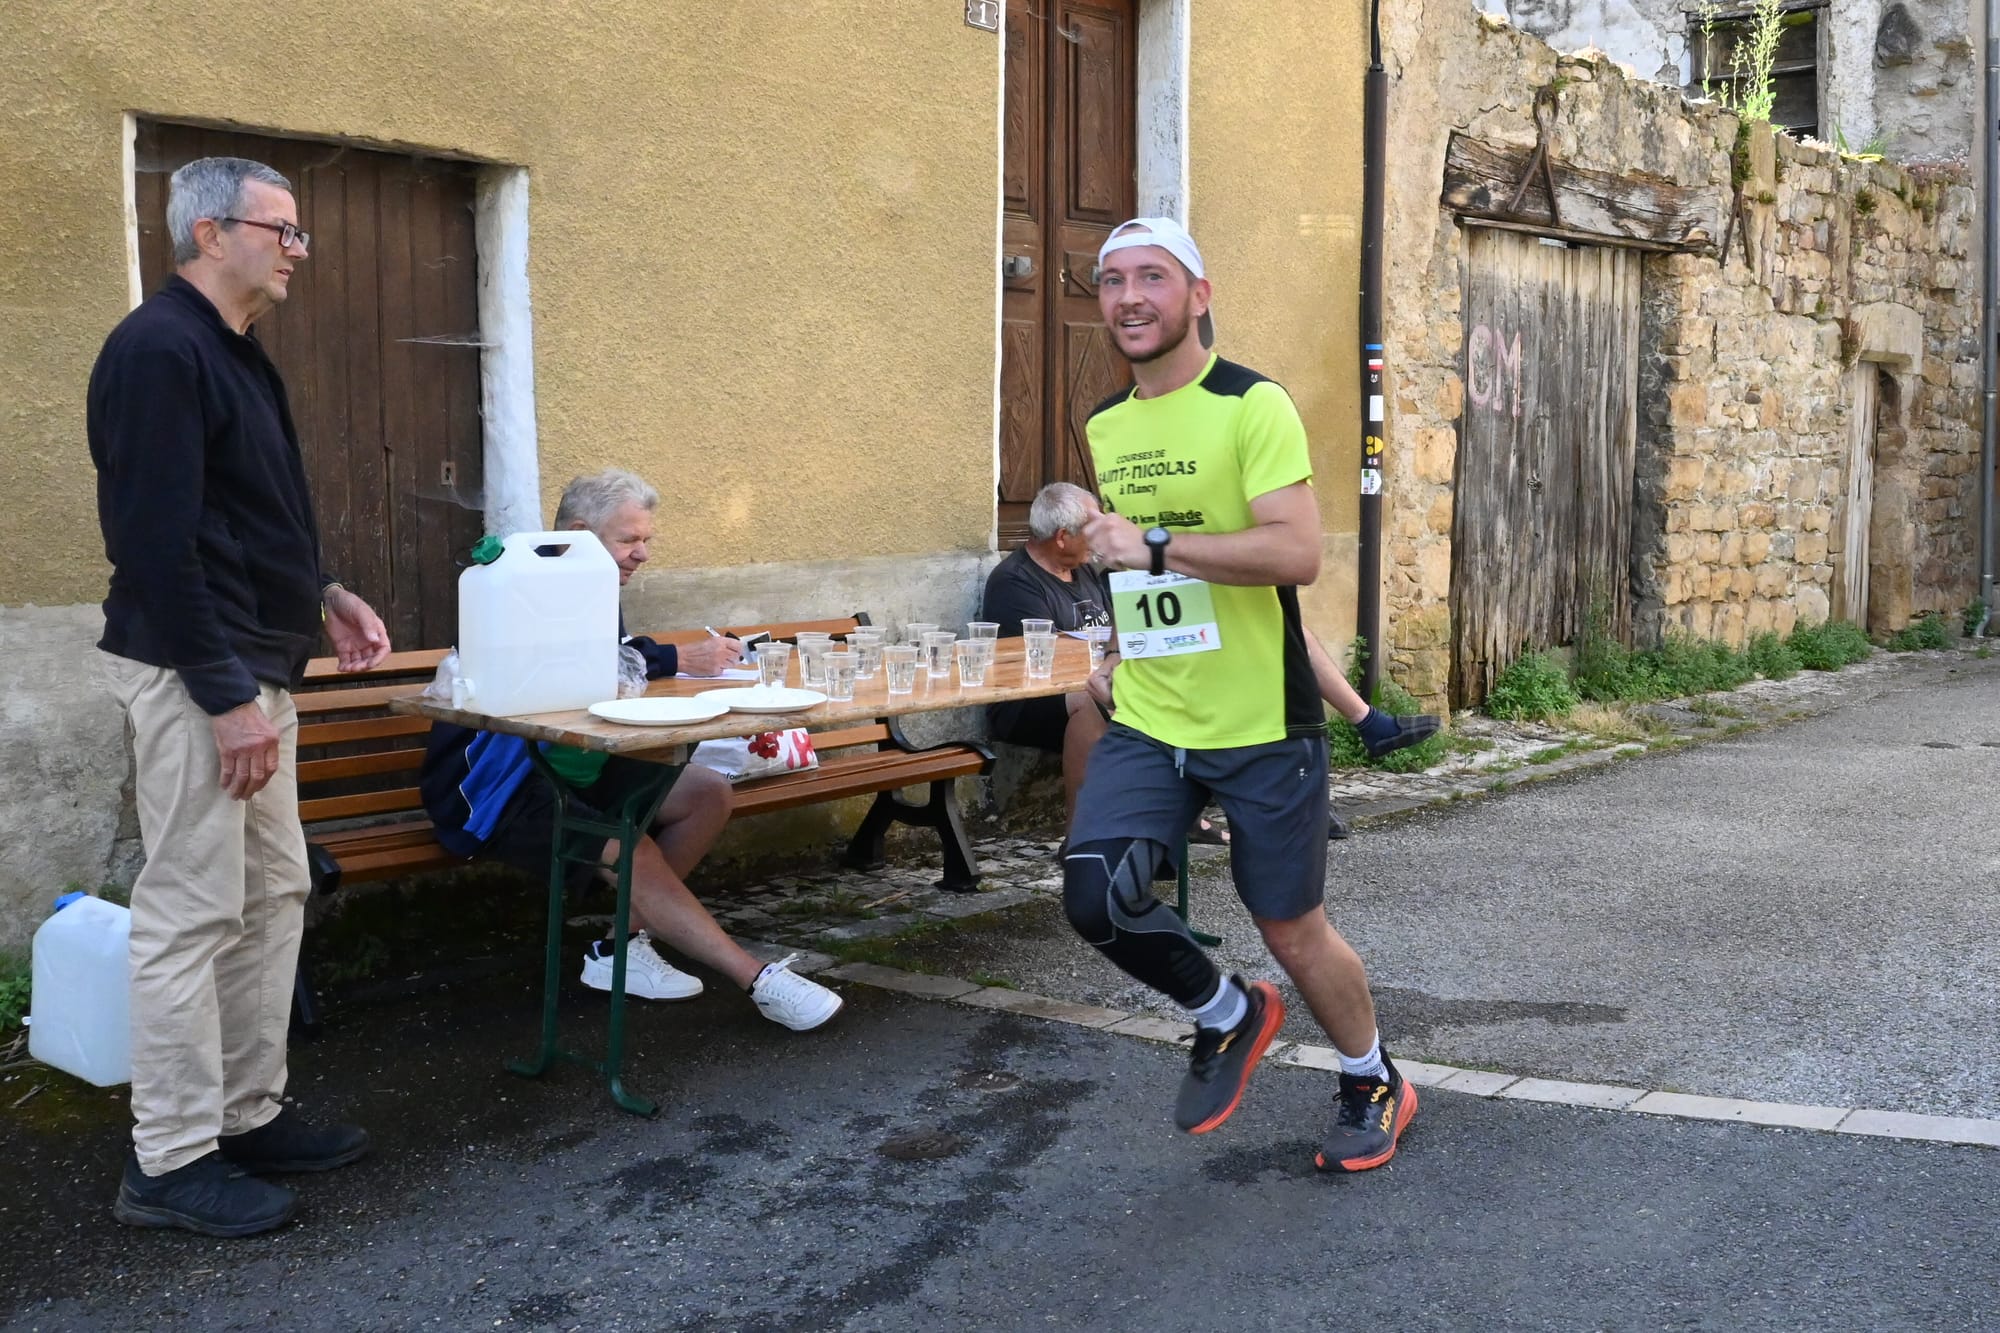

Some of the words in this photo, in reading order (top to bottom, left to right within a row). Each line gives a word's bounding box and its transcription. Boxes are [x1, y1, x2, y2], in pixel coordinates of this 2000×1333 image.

[979, 2, 987, 24] 1
[1116, 451, 1153, 464] COURSES
[1154, 449, 1166, 458] DE
[1127, 483, 1158, 497] Nancy
[1136, 591, 1182, 628] 10
